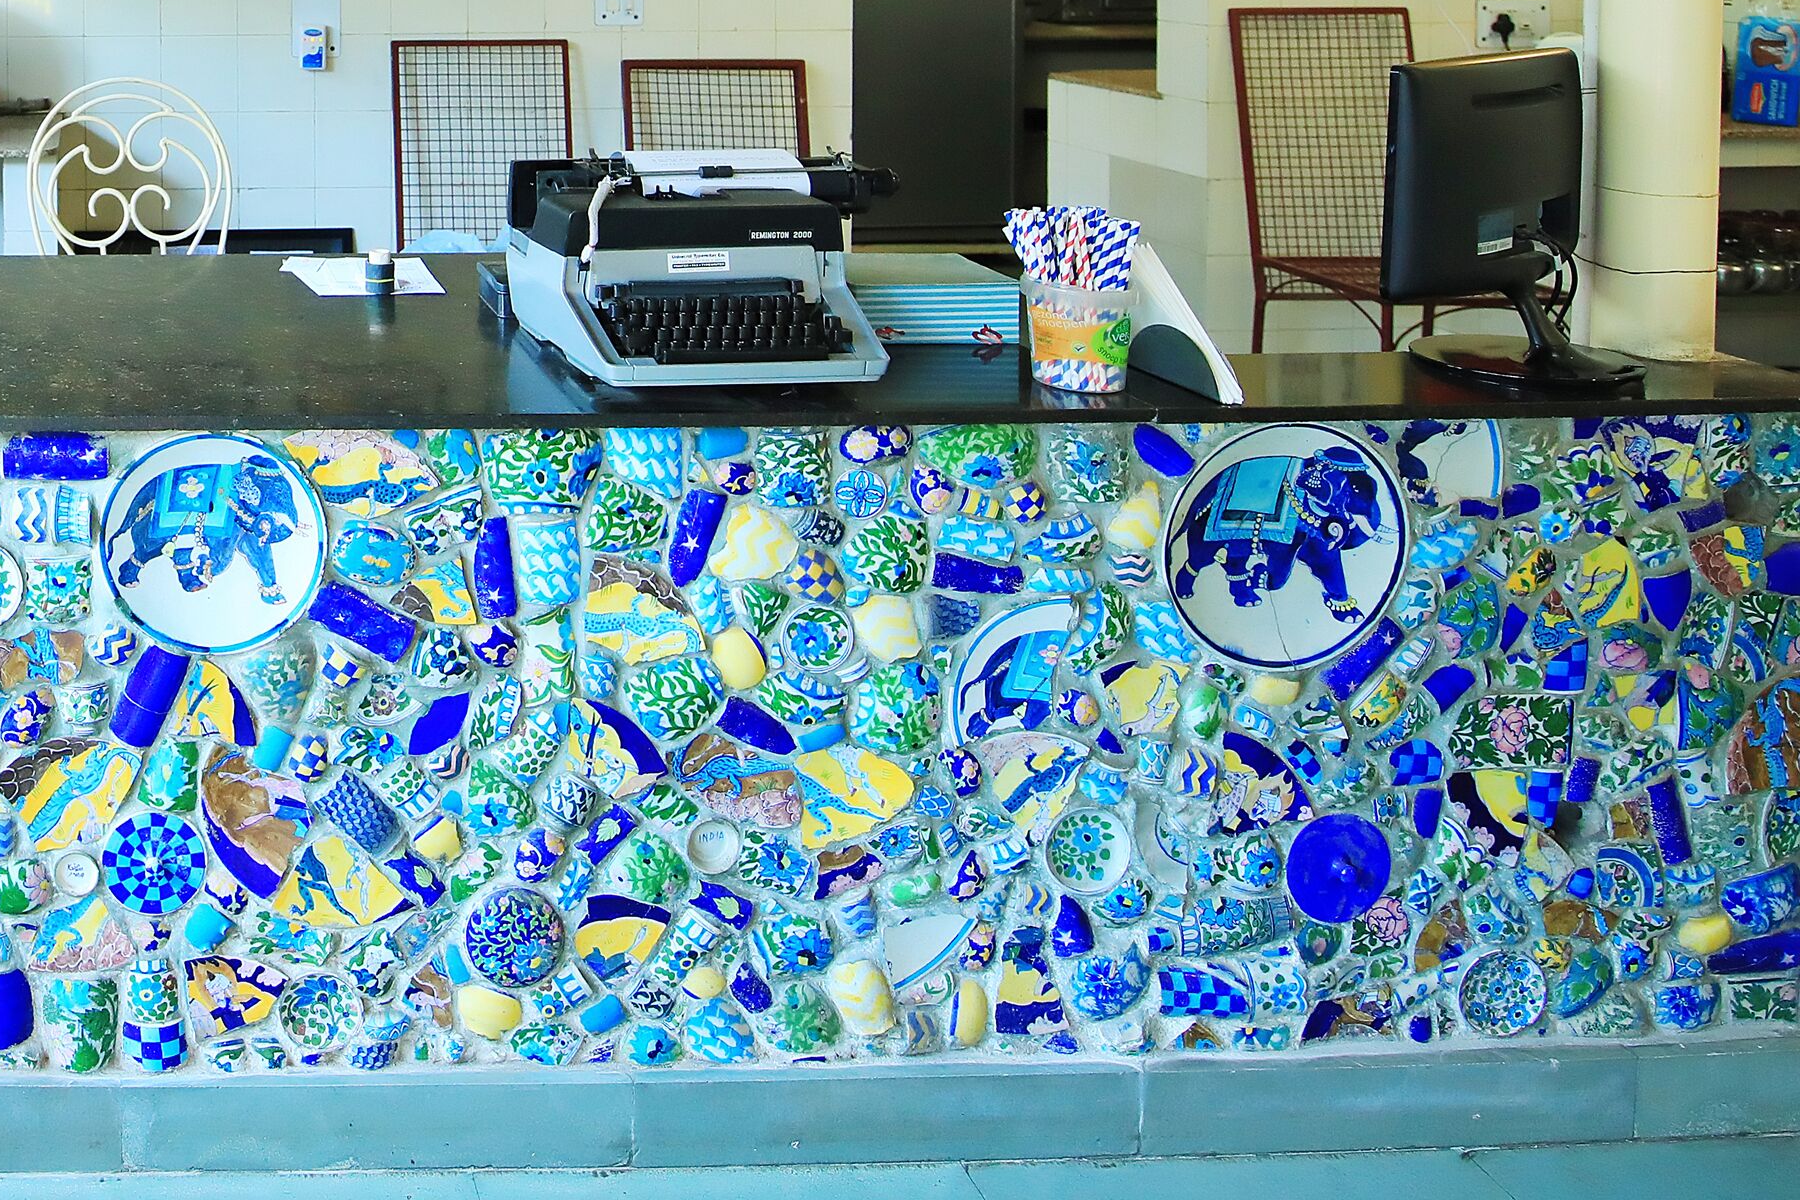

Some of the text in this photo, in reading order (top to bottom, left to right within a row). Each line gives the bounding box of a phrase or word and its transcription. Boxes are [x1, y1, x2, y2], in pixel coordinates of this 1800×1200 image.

[750, 231, 813, 240] REMINGTON 2000
[698, 831, 725, 843] INDIA
